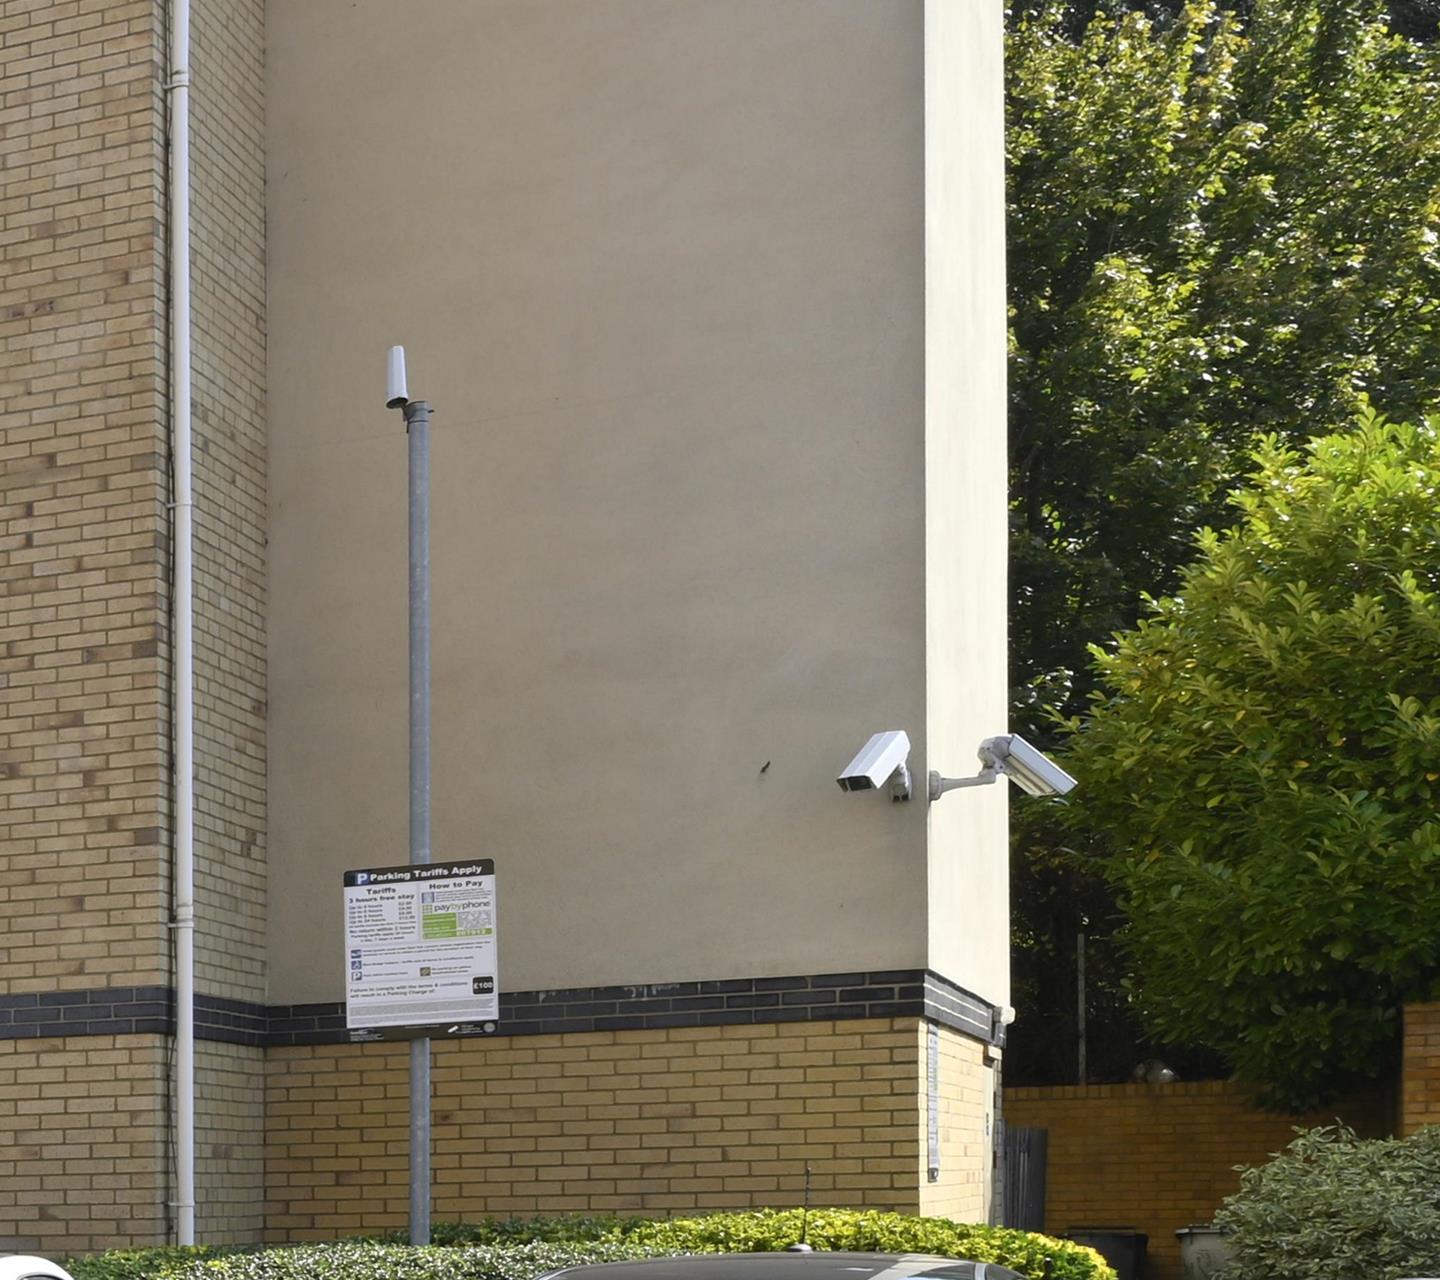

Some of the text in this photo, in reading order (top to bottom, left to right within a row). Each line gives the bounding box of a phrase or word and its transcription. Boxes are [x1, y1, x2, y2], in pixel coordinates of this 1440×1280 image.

[370, 871, 410, 883] Parking
[414, 867, 449, 878] Tariffs
[451, 865, 482, 875] Apply
[465, 880, 483, 888] Pay
[366, 887, 396, 895] Tariffs
[434, 900, 491, 912] paybyphone
